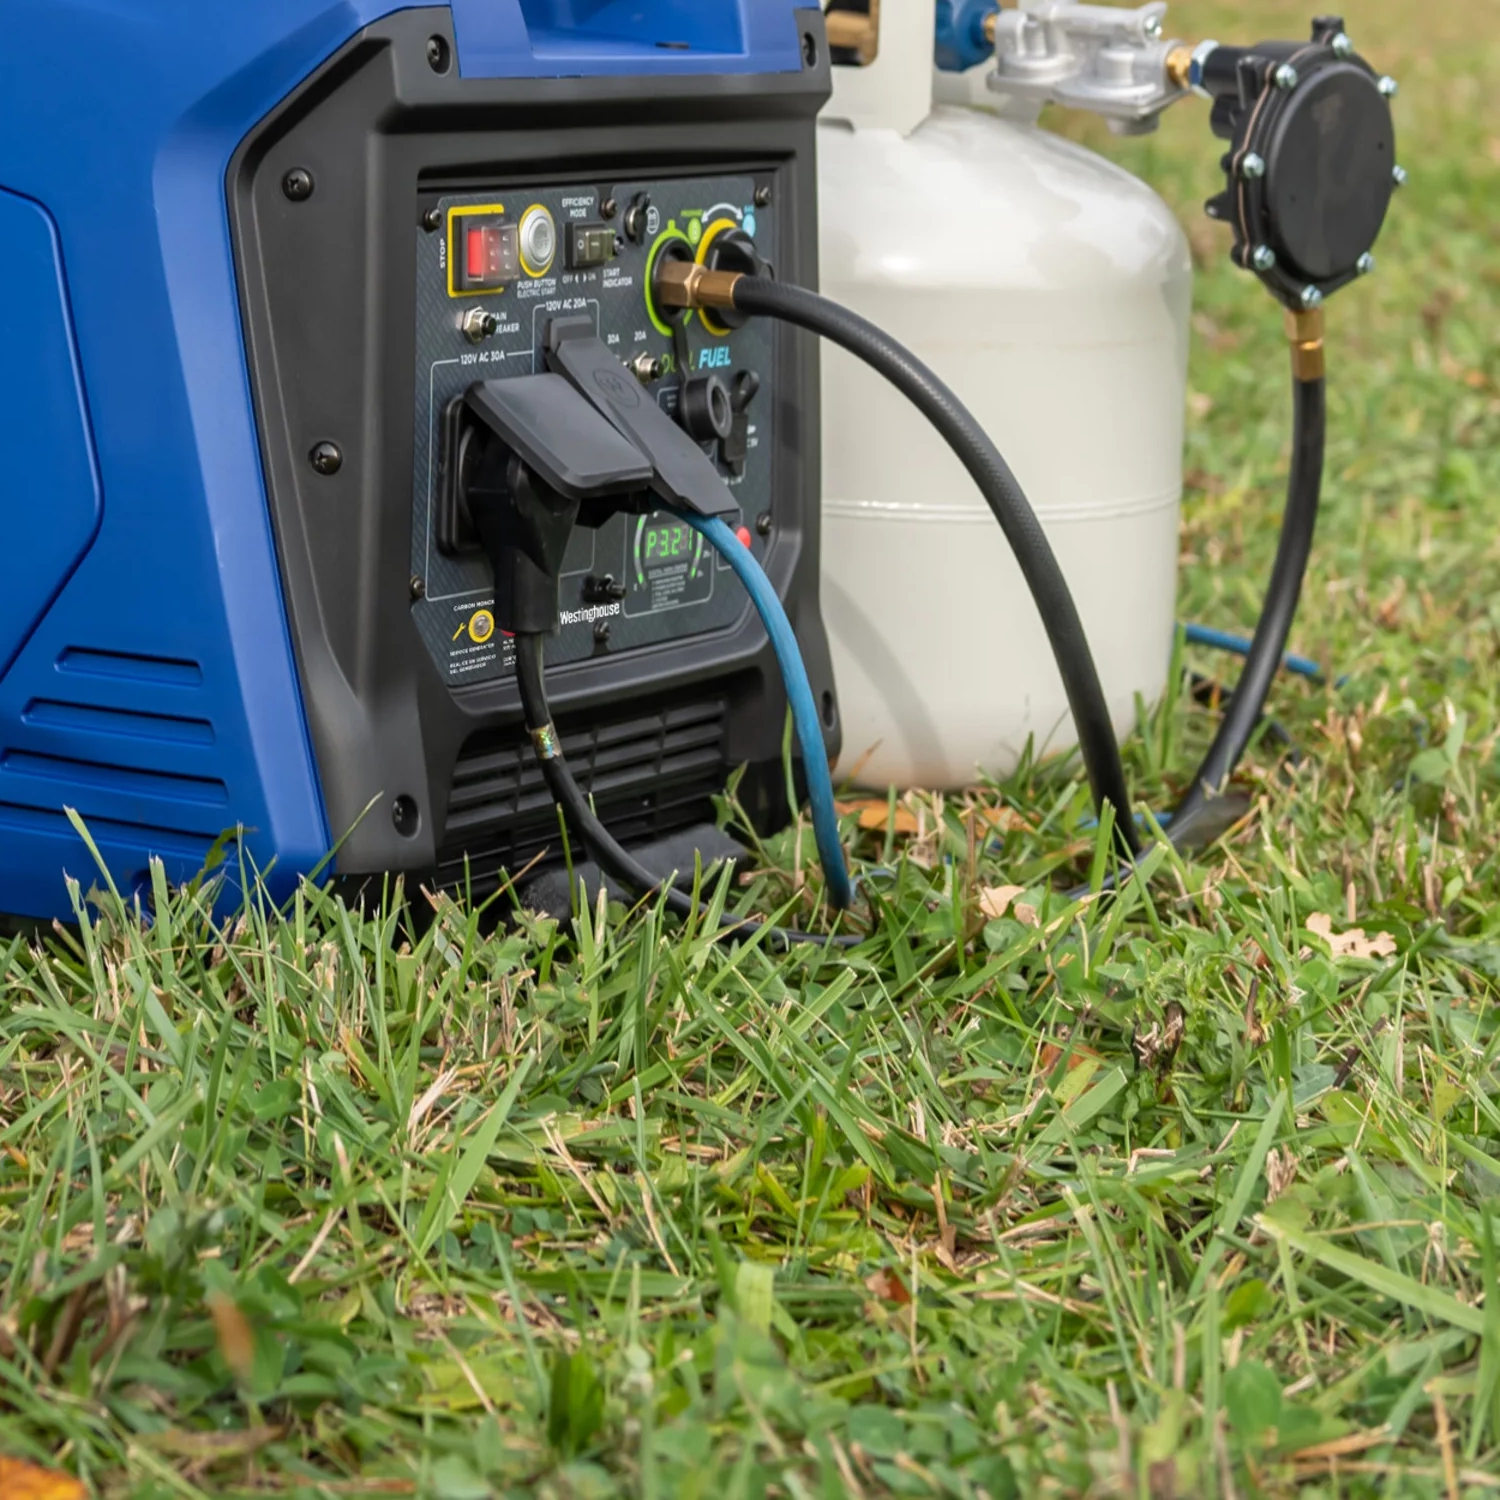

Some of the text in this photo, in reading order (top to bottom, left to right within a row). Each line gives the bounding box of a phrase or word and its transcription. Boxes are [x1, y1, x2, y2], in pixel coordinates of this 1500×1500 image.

[569, 208, 587, 218] MODE
[603, 268, 620, 277] START
[517, 278, 556, 289] PUSH BUTTON
[603, 276, 633, 288] INDICATOR
[545, 298, 587, 310] 120V AC 20A
[460, 350, 505, 364] 120V AC 30A
[698, 346, 731, 369] FUEL
[453, 599, 495, 612] CARBON MONOX
[560, 603, 620, 625] Westinghouse
